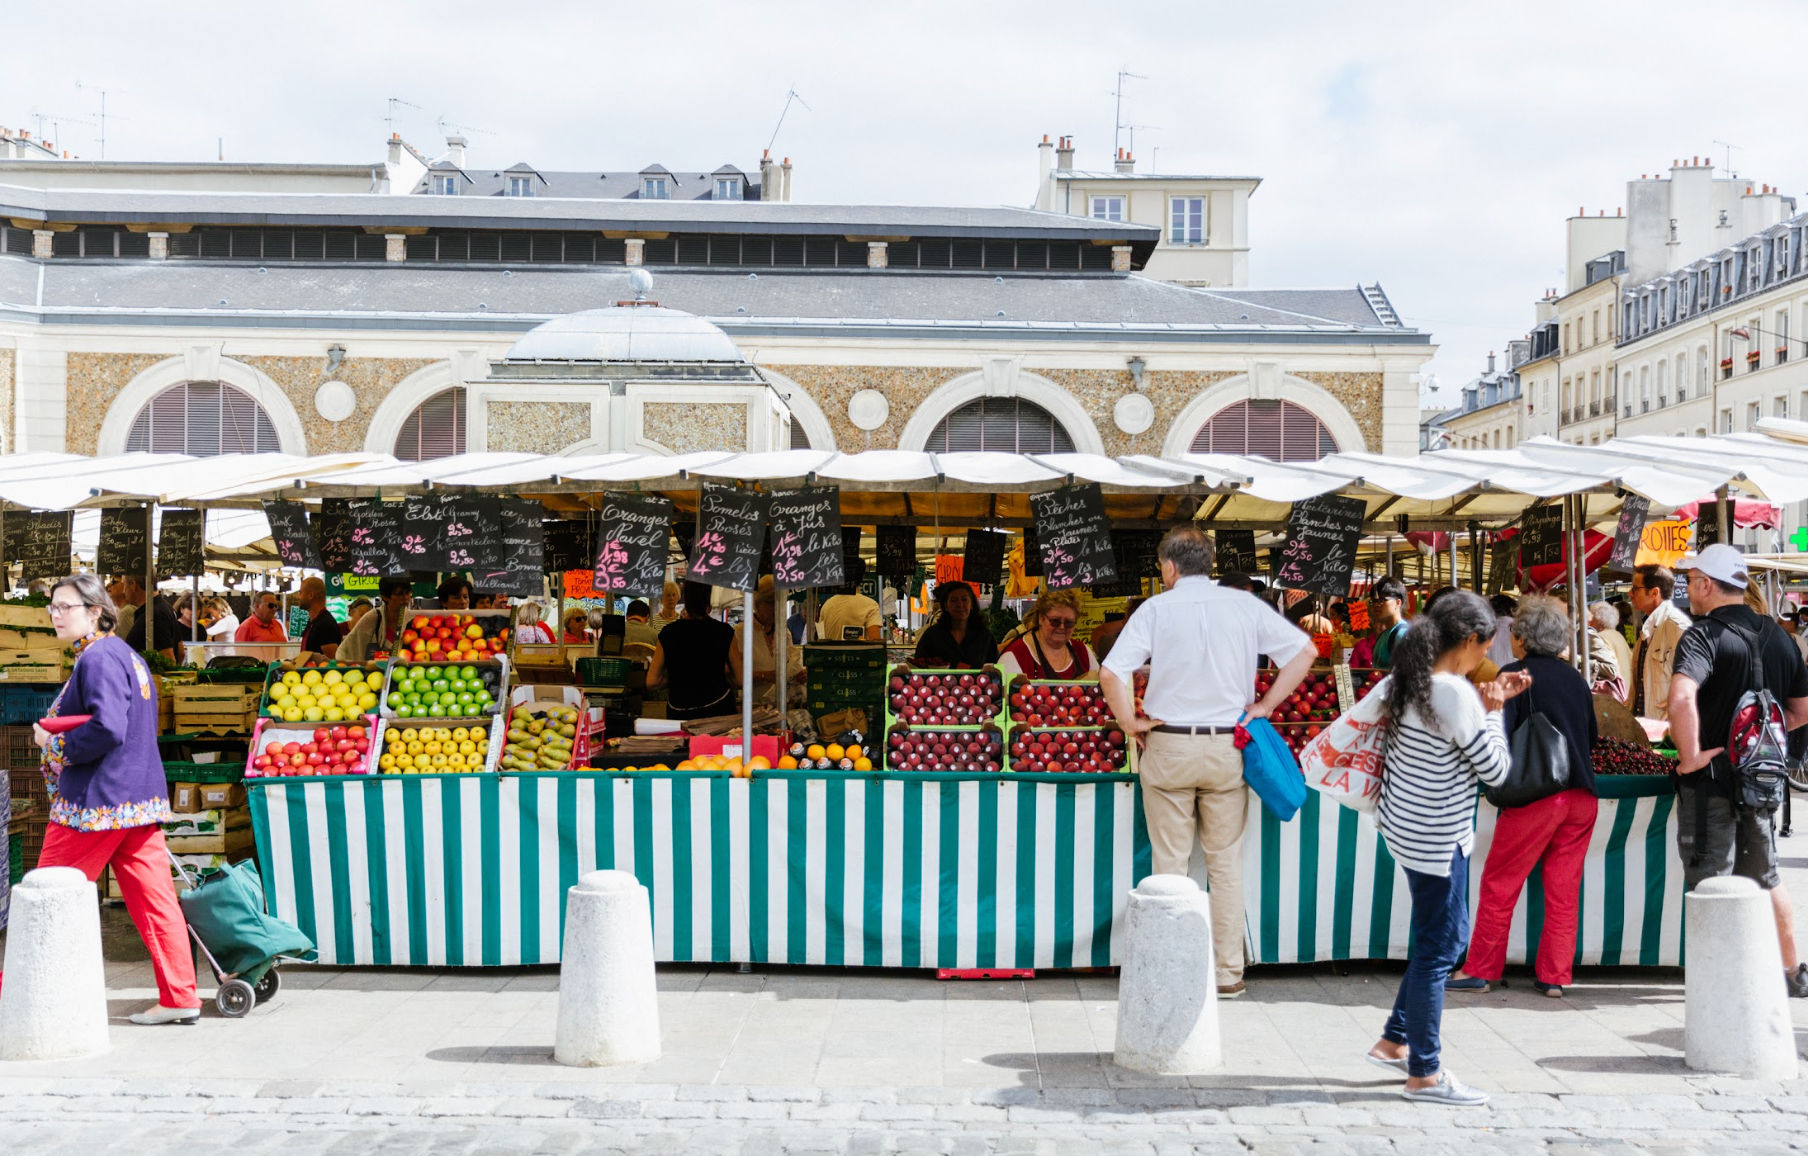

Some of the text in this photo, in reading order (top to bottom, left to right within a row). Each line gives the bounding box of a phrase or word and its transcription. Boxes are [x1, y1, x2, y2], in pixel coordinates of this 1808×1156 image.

[601, 504, 669, 533] Oranges
[701, 494, 760, 521] Pomelos
[769, 500, 832, 521] Oranges
[1036, 513, 1084, 534] Blanches
[606, 522, 664, 548] Navel
[812, 571, 824, 584] 2
[1081, 573, 1094, 584] 2
[1320, 770, 1350, 794] LA
